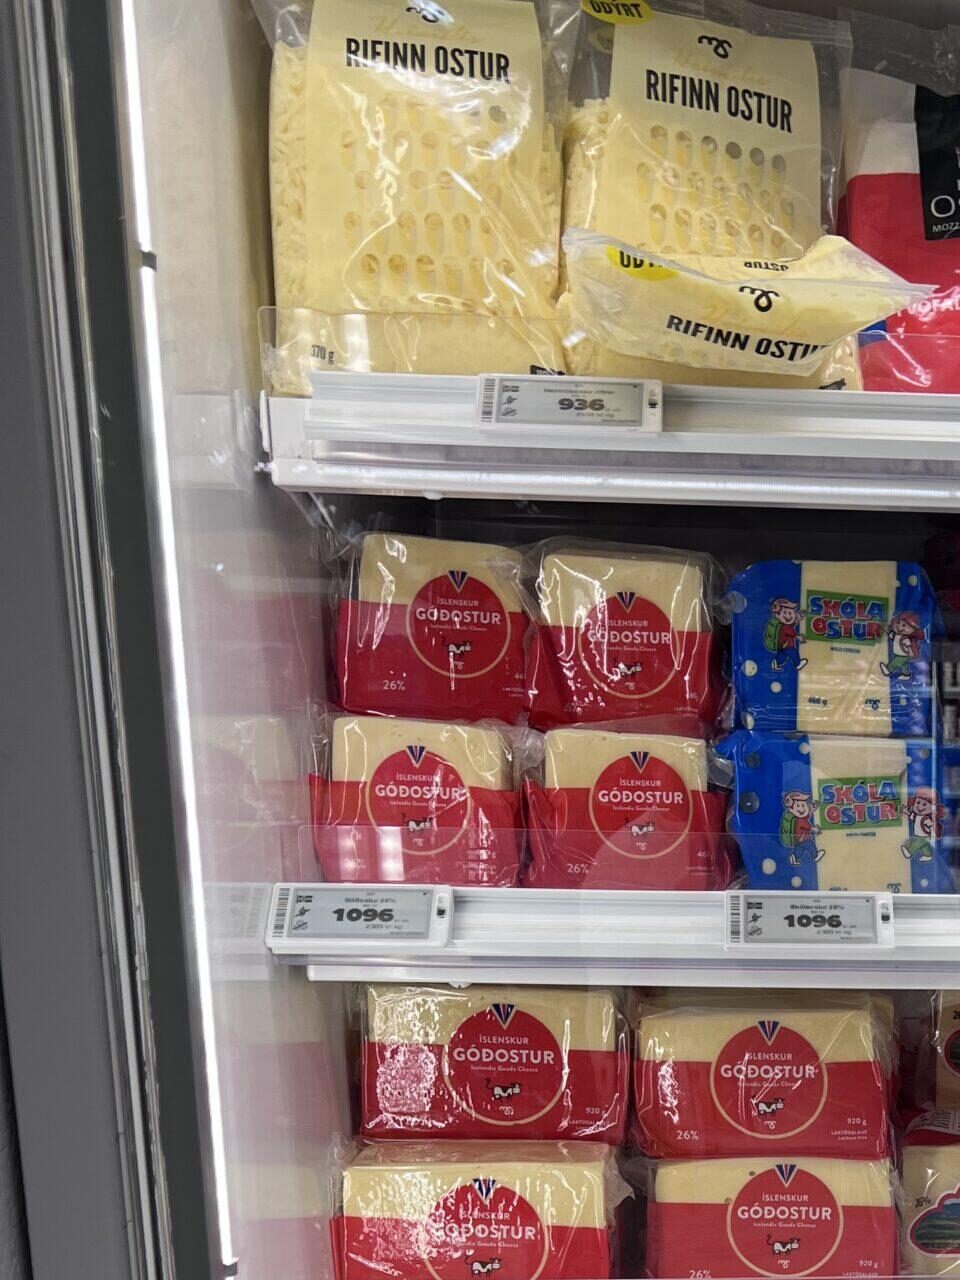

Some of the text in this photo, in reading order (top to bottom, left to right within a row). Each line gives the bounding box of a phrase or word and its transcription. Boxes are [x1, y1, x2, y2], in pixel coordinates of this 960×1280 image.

[345, 38, 510, 84] RIFINN OSTUR
[645, 69, 793, 133] RIFINN OSTUR
[666, 315, 750, 351] RIFINN
[311, 343, 326, 361] 370
[558, 399, 605, 412] 936
[437, 595, 479, 607] ÍSLENSKUR
[807, 593, 888, 623] SKÓLA
[415, 605, 502, 627] GÓÐOSTUR
[811, 617, 884, 641] OSTUR
[383, 679, 406, 691] 26%
[375, 781, 461, 801] GÓÐOSTUR
[619, 777, 661, 789] ÍSLENSKUR
[820, 776, 899, 804] SKÓLA
[598, 788, 684, 807] GÓÐOSTUR
[825, 799, 899, 827] OSTUR
[566, 862, 590, 874] 26%
[332, 907, 395, 923] 1096
[783, 913, 843, 929] 1096
[479, 1034, 529, 1045] ÍSLENSKUR
[452, 1044, 555, 1065] GÓÐOSTUR
[720, 1061, 816, 1079] GÓÐOSTUR
[676, 1130, 700, 1141] 26%
[761, 1192, 809, 1202] ÍSLENSKUR
[737, 1202, 832, 1221] GÓÐOSTUR
[689, 1269, 712, 1280] 26%
